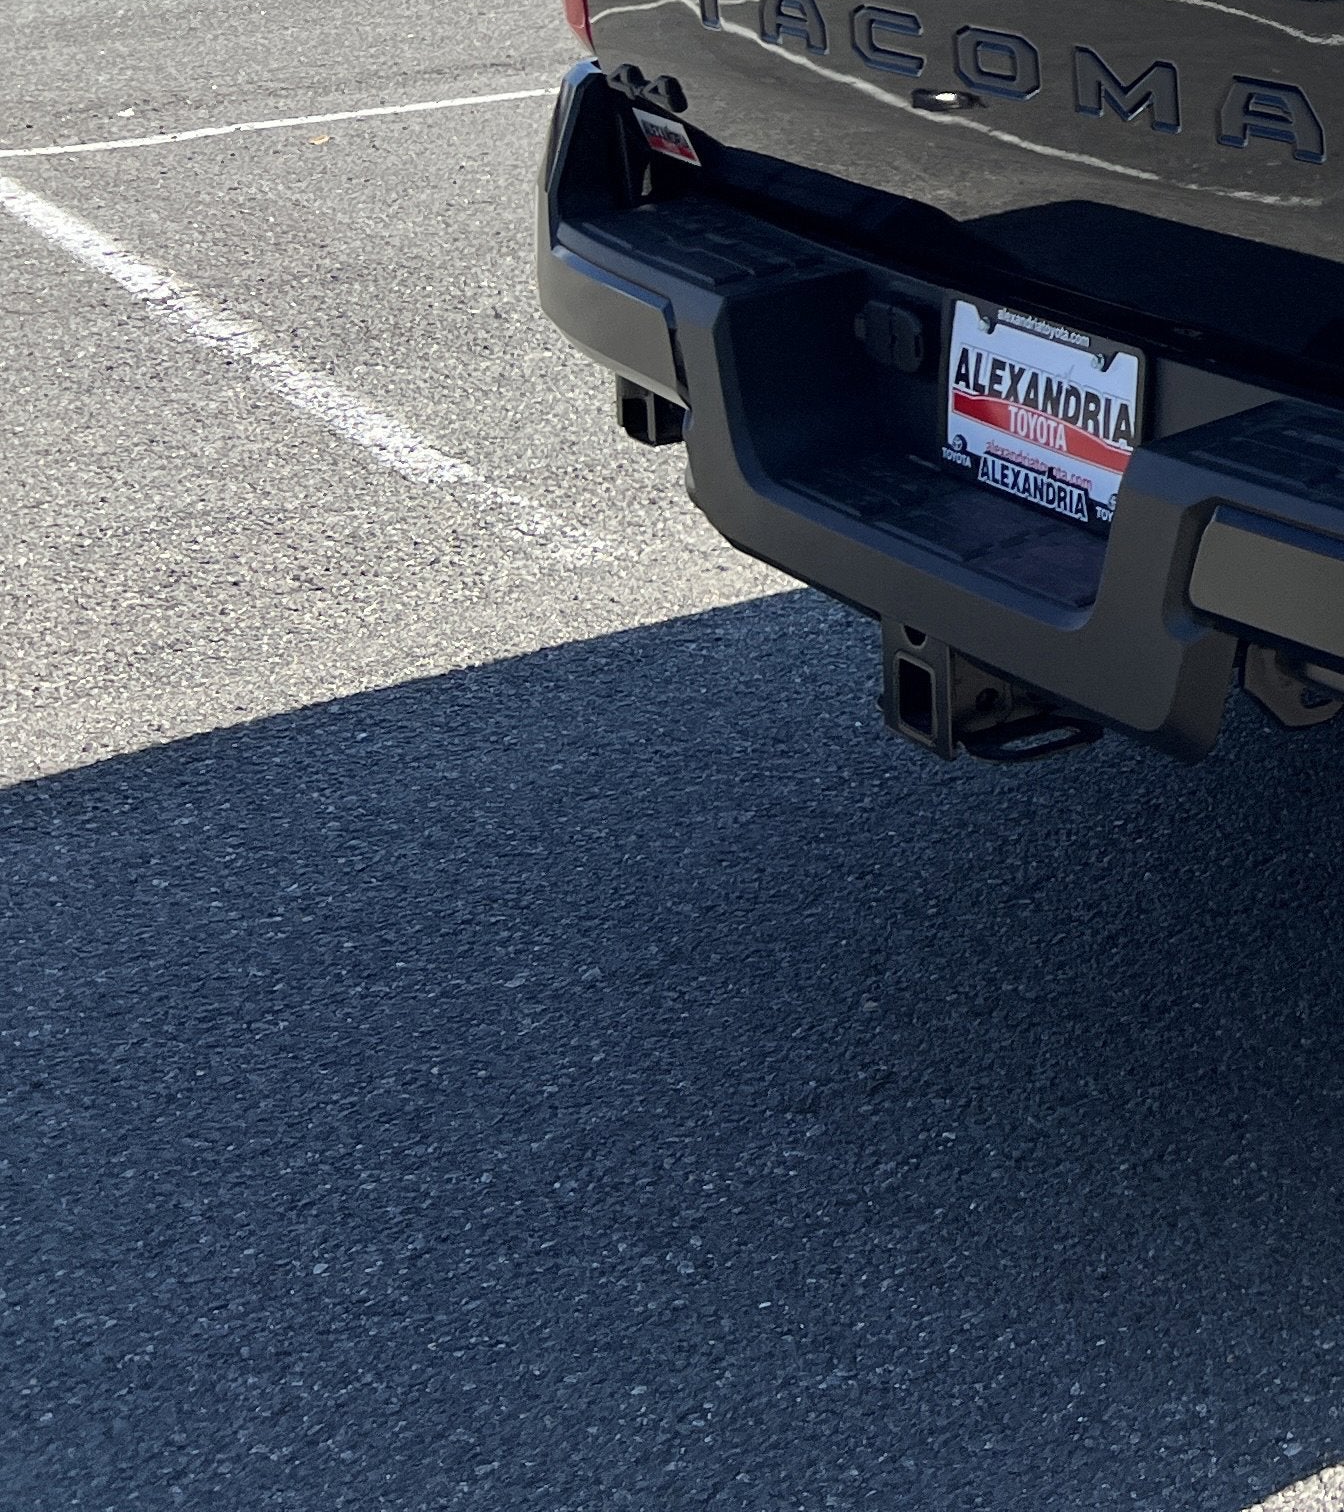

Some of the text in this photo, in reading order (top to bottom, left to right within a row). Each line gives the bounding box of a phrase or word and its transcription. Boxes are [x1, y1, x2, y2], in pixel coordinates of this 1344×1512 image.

[997, 307, 1090, 348] alexandriatoyota.com
[953, 347, 1135, 446] ALEXANDRIA
[1007, 405, 1069, 452] TOYOTA
[941, 446, 972, 469] TOYOTA
[979, 456, 1088, 521] ALEXANDRIA
[1095, 505, 1114, 523] TOY
